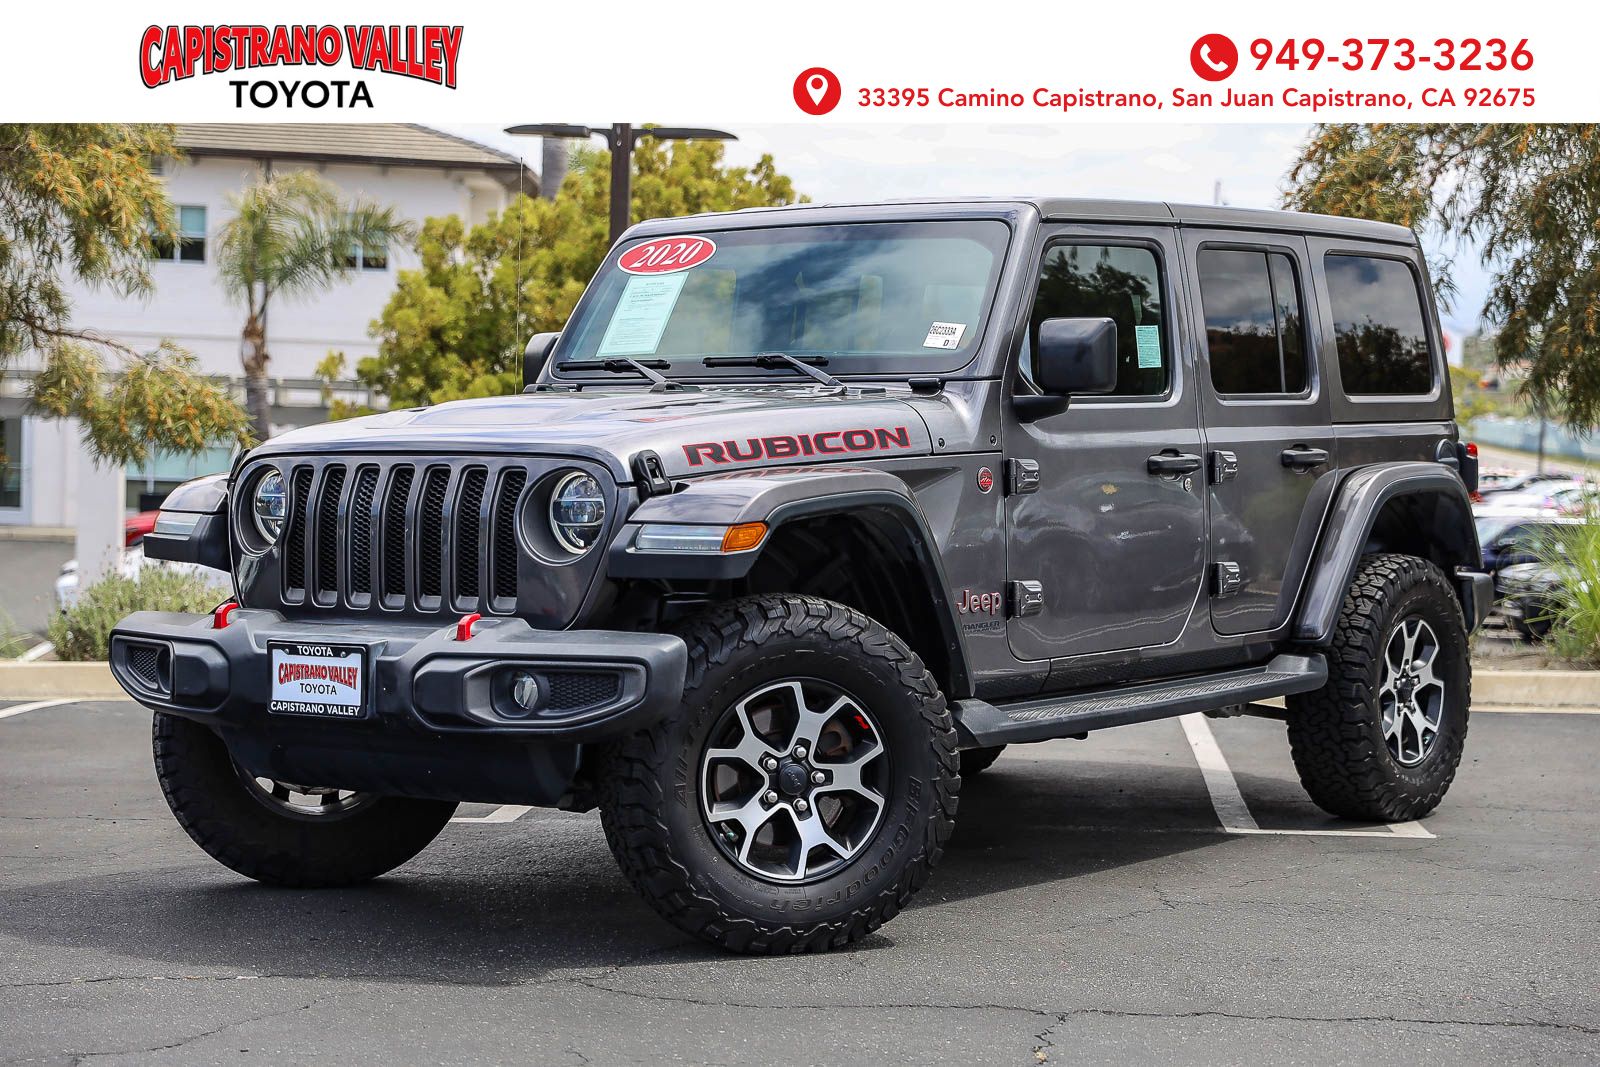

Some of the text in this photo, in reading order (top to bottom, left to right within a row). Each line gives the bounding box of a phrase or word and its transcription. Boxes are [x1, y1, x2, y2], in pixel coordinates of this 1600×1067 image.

[629, 240, 704, 268] 2020
[682, 426, 912, 467] RUBICON
[957, 589, 1002, 615] Jeep
[297, 645, 334, 657] TOYOTA
[278, 662, 359, 690] CAPISTRANO VALLEY
[299, 682, 337, 696] TOYOTA
[270, 701, 360, 716] CAPISTRANO VALLEY
